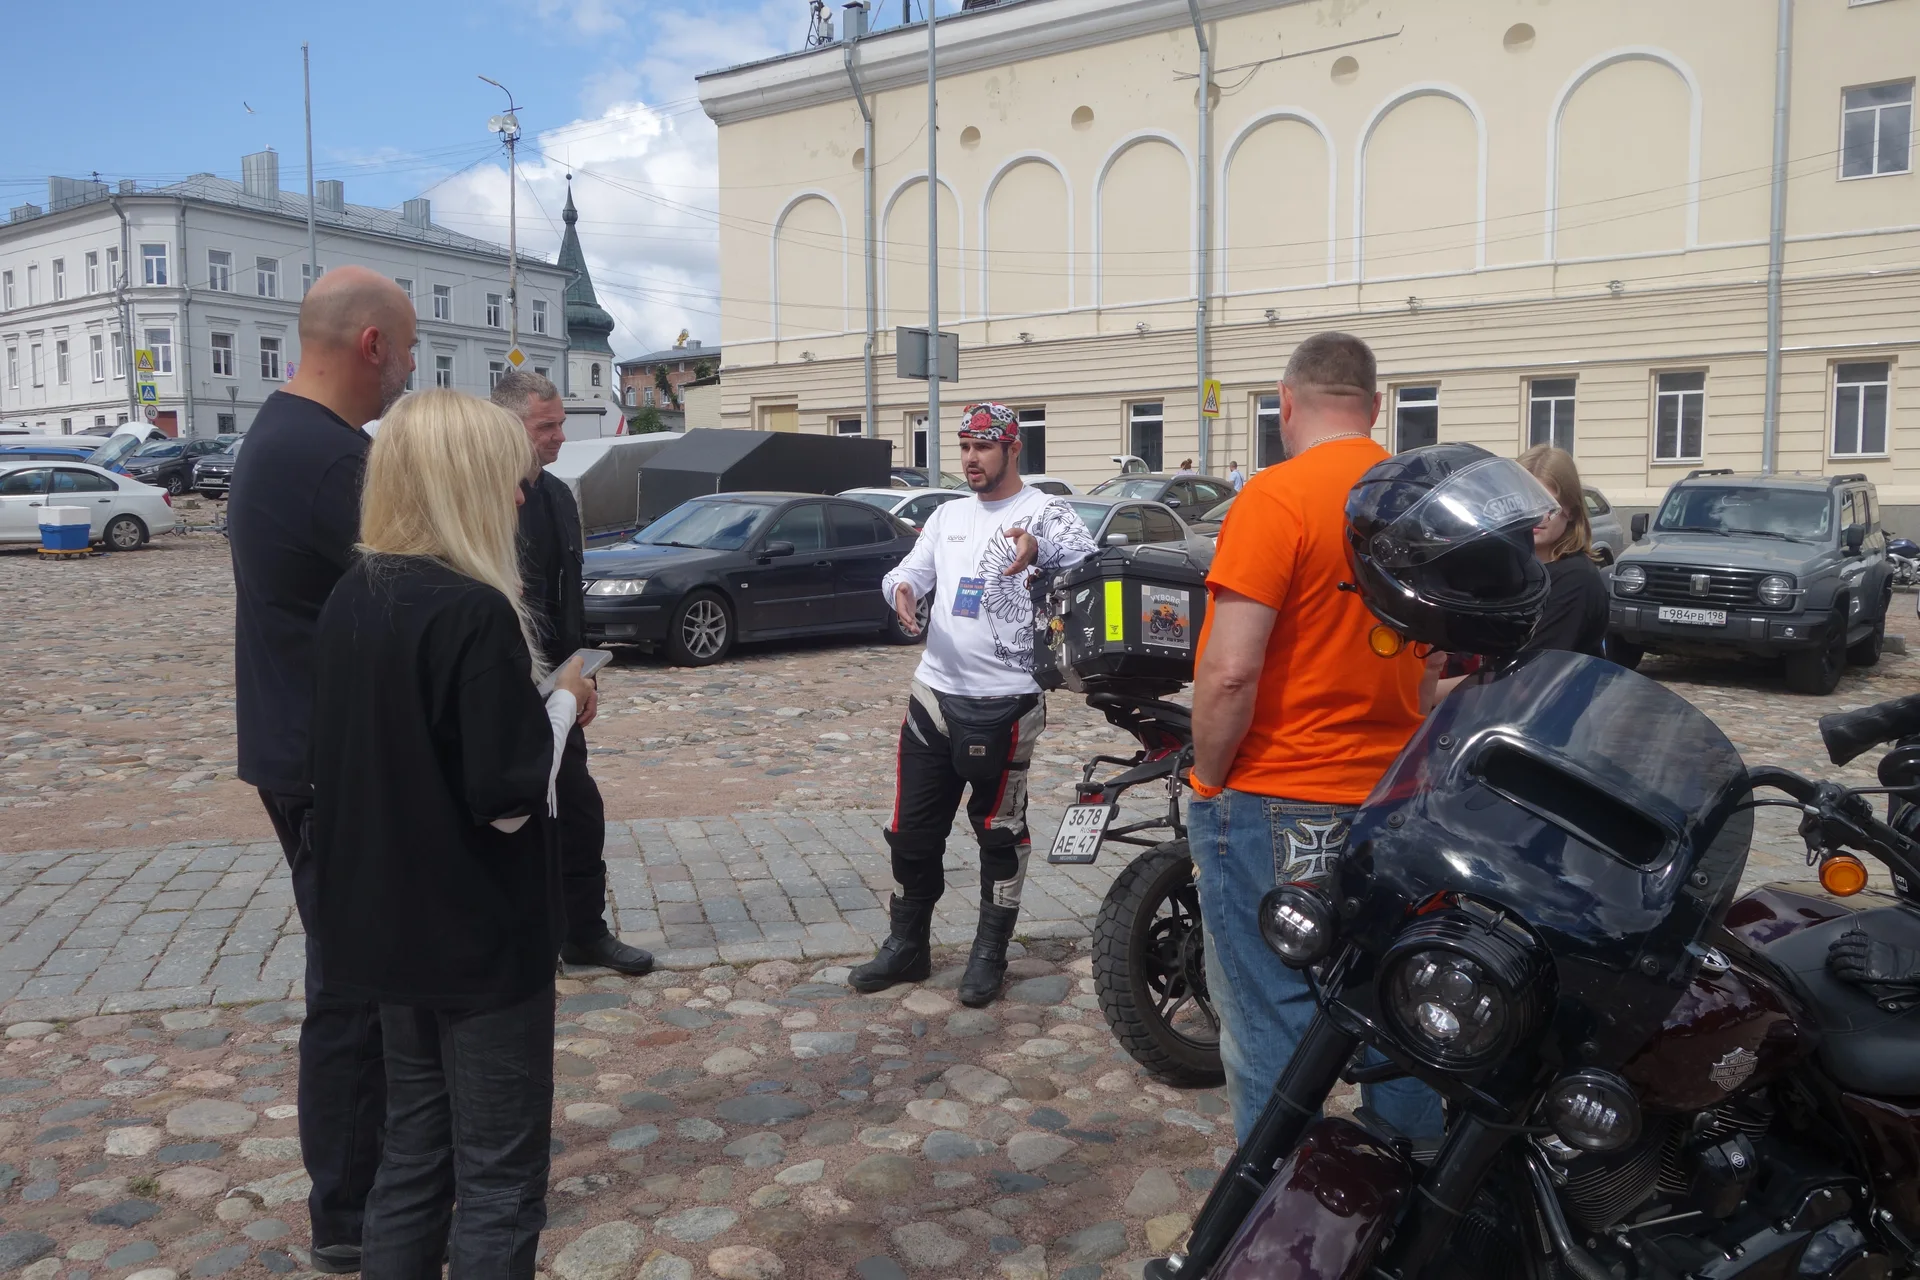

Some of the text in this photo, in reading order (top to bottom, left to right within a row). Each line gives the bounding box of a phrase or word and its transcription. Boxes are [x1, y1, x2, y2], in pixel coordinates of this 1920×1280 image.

[147, 409, 156, 417] 40
[1150, 594, 1181, 604] VYBORG
[1663, 609, 1704, 621] Т984РВ
[1707, 611, 1724, 620] 198
[1069, 809, 1103, 826] 3678
[1078, 835, 1097, 853] 47
